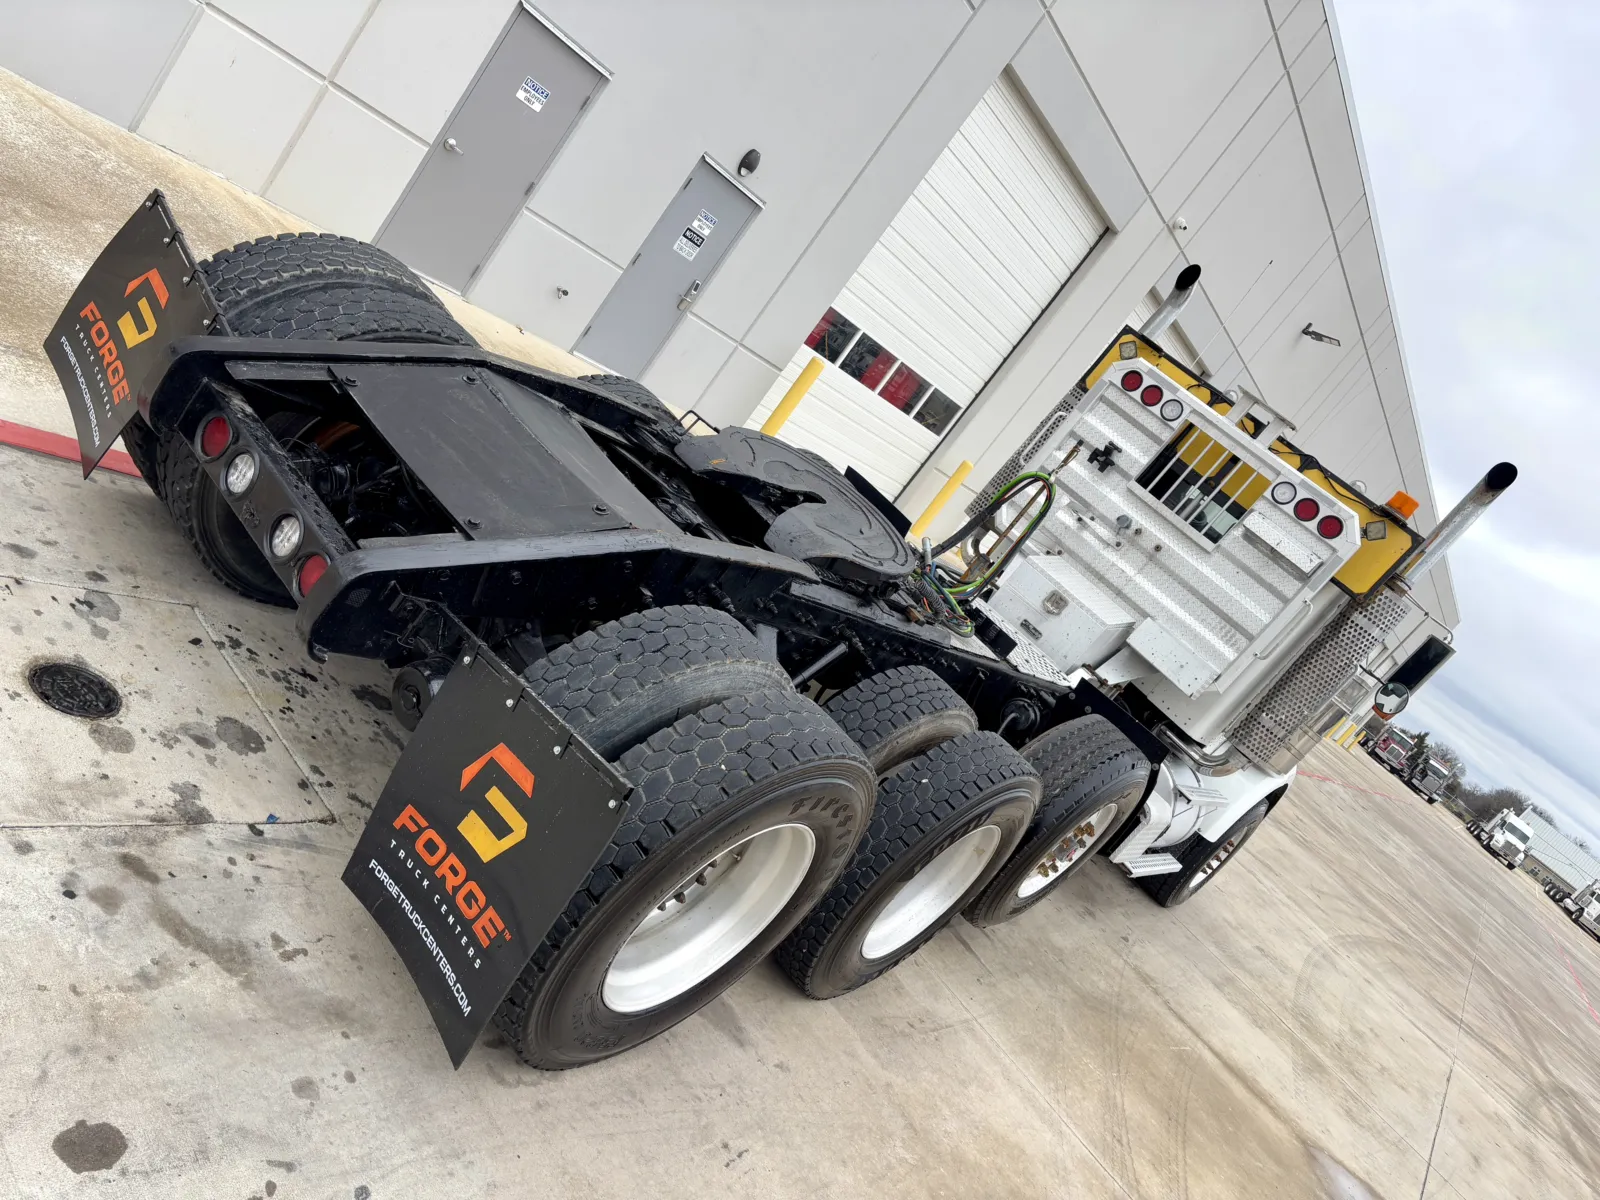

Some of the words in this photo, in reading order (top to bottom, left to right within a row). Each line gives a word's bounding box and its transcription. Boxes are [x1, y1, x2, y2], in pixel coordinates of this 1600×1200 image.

[520, 86, 544, 105] EMPLOYEES
[523, 96, 535, 106] ONLY
[525, 79, 549, 99] NOTICE
[684, 230, 703, 246] NOTICE
[59, 335, 101, 448] FORGETRUCKCENTERS.COM
[74, 323, 95, 364] TRUCK
[93, 365, 112, 419] CENTERS
[389, 838, 429, 889] TRUCK
[433, 895, 481, 970] CENTERS
[368, 858, 472, 1018] FORGETRUCKCENTERS.COM
